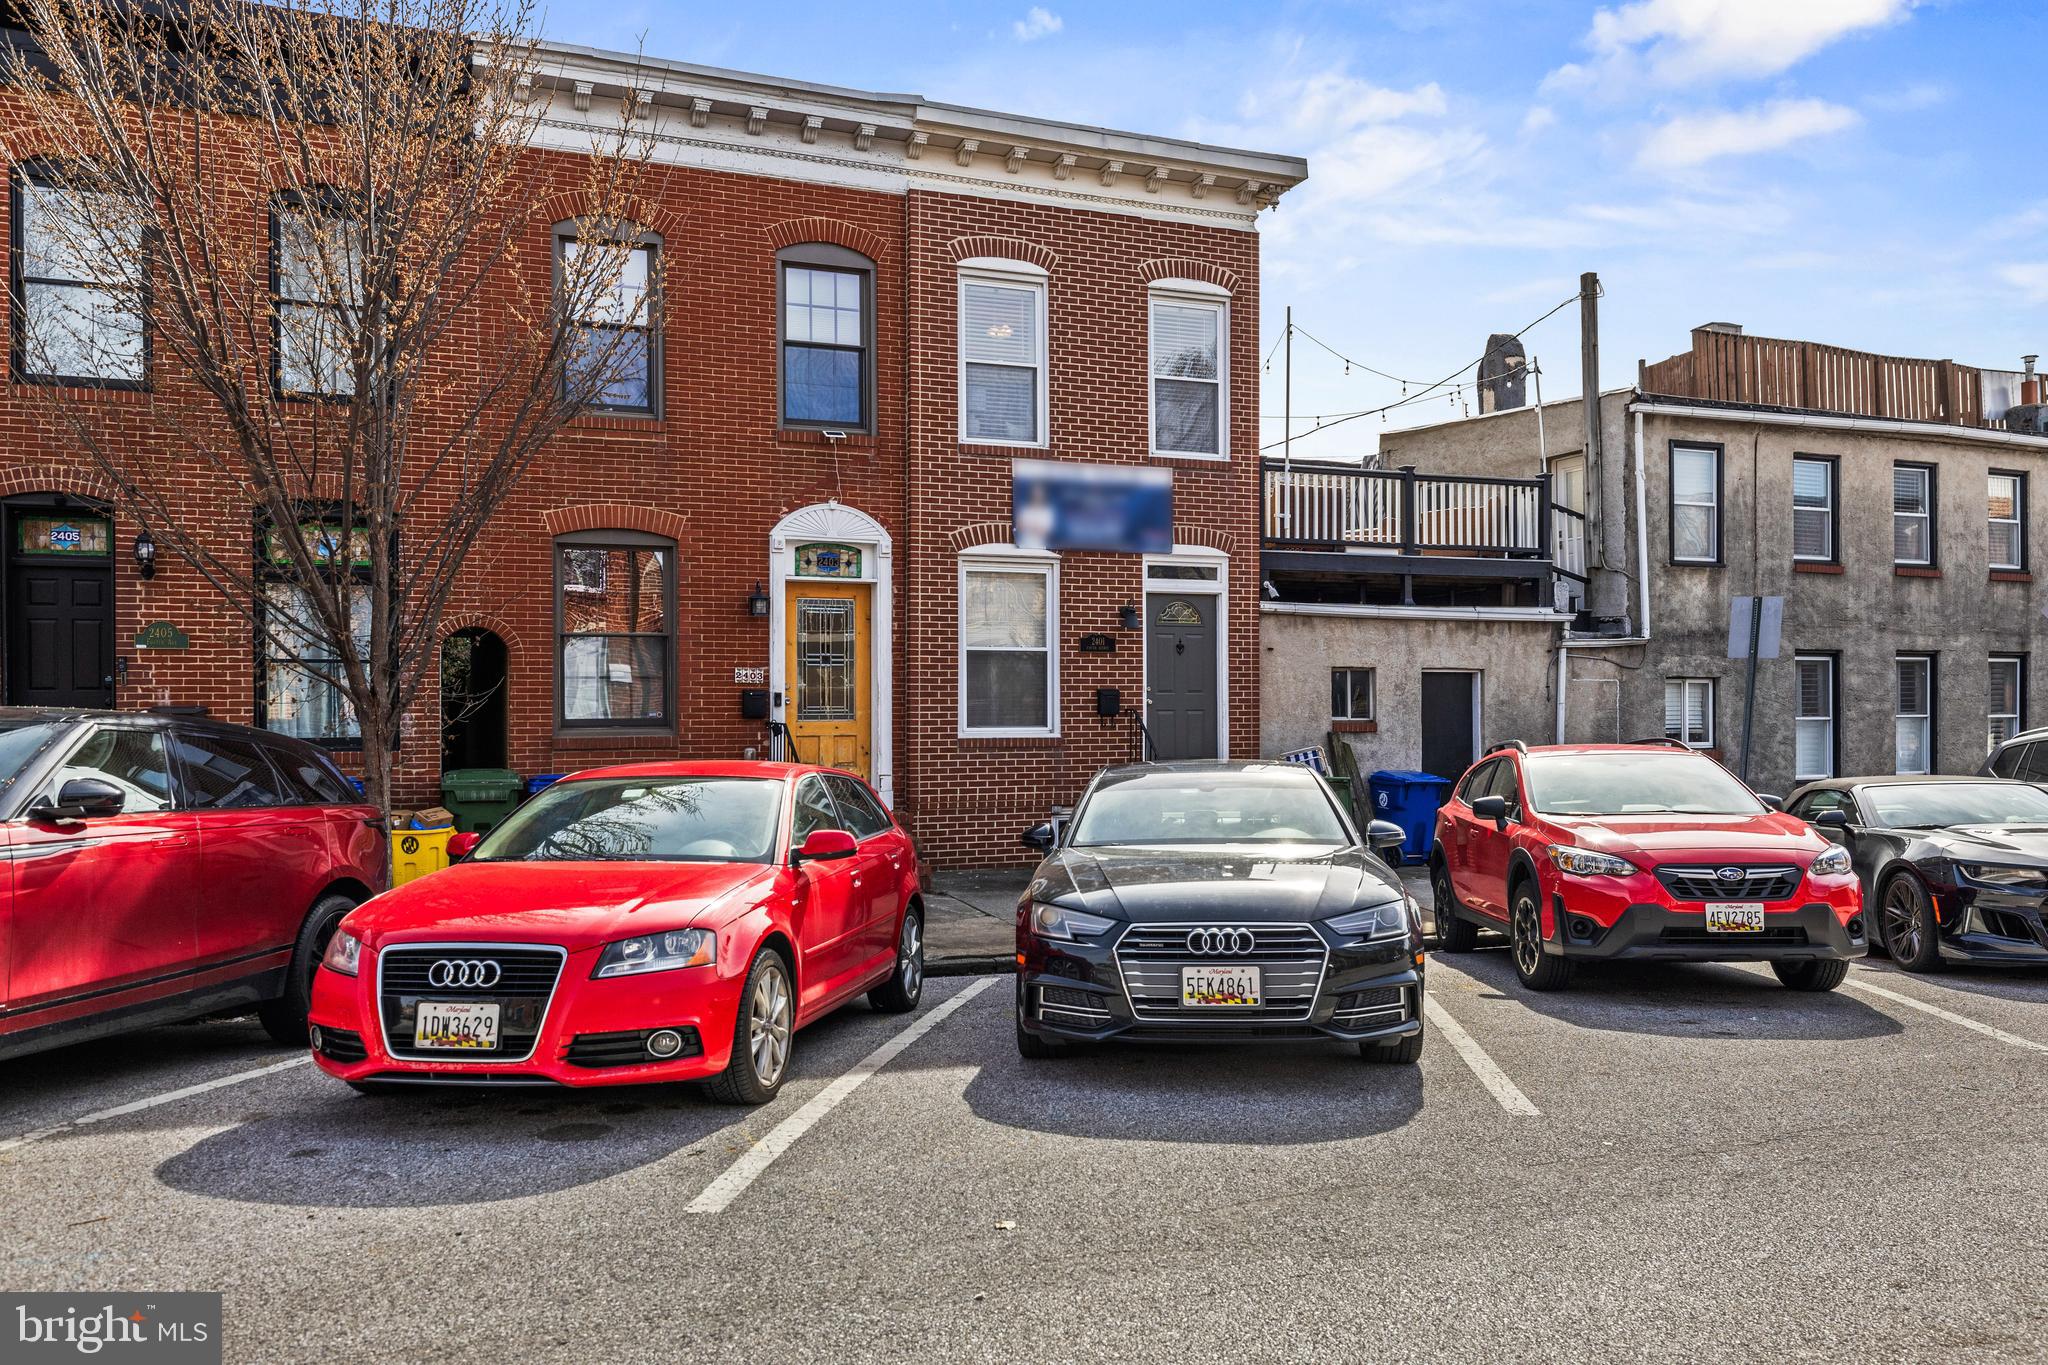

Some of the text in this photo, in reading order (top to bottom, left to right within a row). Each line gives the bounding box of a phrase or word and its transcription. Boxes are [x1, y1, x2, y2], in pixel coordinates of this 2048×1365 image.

[51, 531, 80, 541] 2405
[819, 558, 839, 566] 2403
[149, 627, 173, 638] 2405
[1091, 637, 1105, 646] 2401
[735, 671, 763, 680] 2403
[1710, 911, 1761, 927] 4EV2785
[1208, 968, 1233, 976] Maryland
[1186, 977, 1254, 998] 5EK4861
[446, 1006, 472, 1014] Maryland
[423, 1015, 493, 1040] 1DW3629
